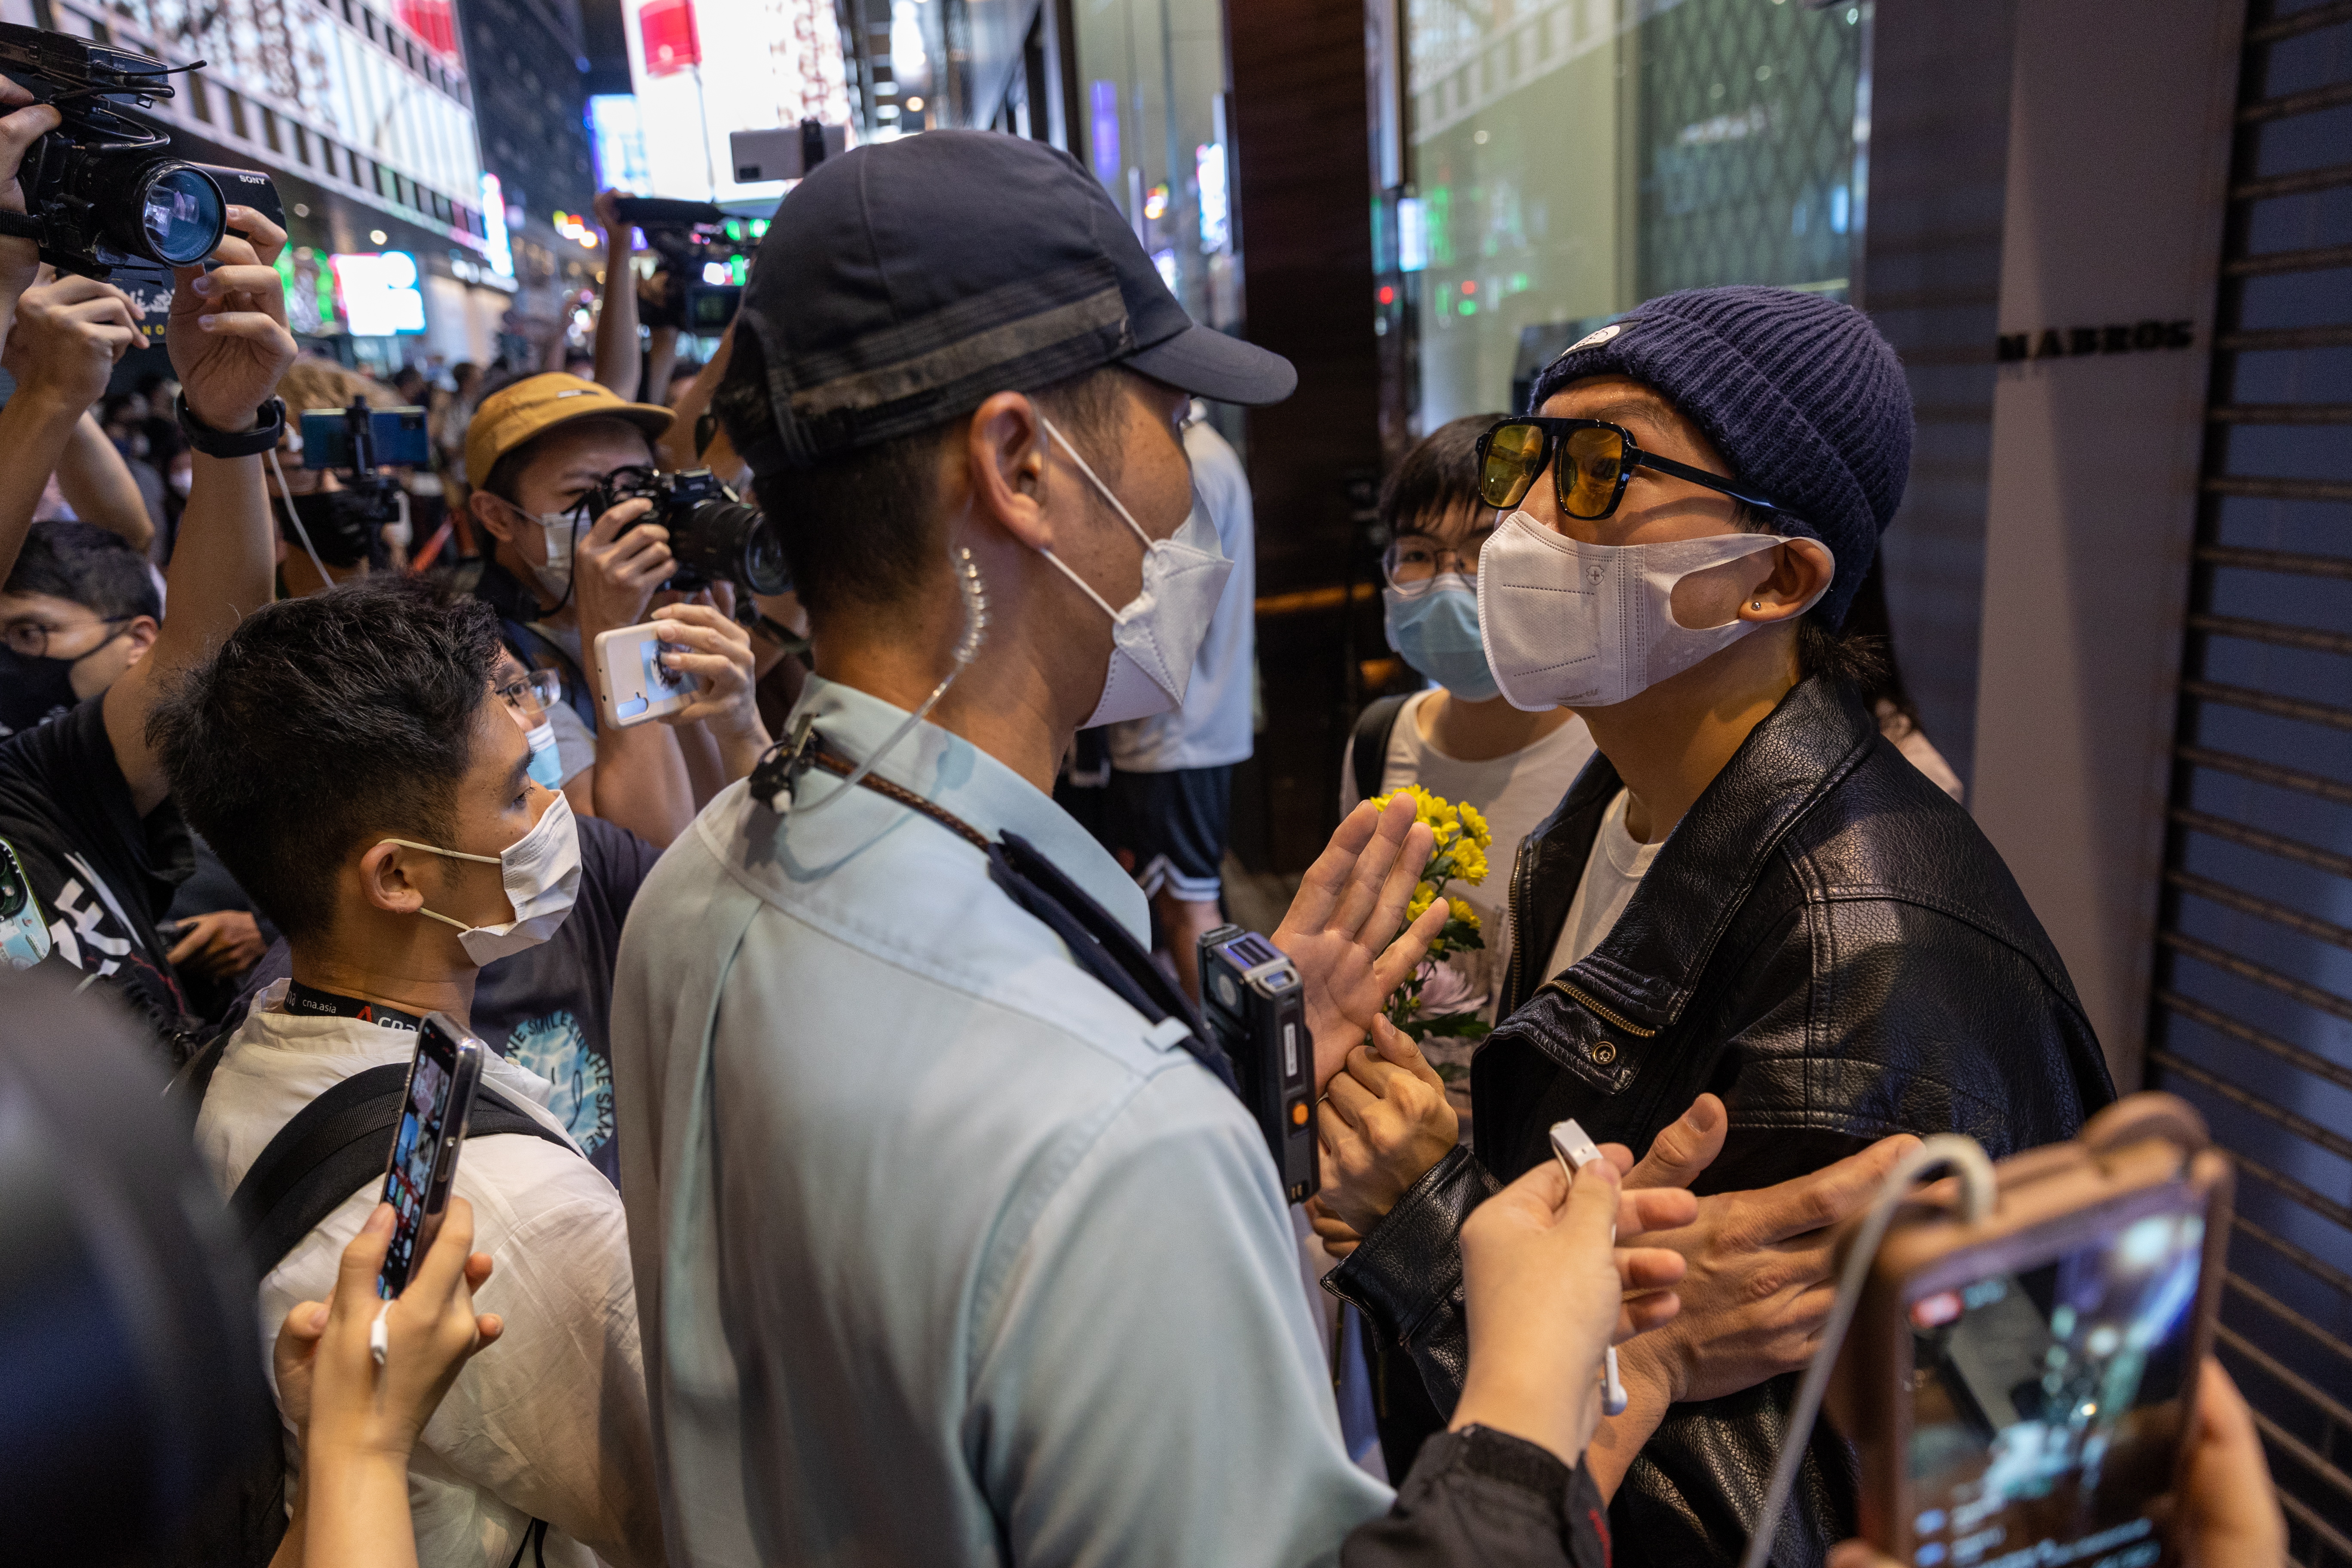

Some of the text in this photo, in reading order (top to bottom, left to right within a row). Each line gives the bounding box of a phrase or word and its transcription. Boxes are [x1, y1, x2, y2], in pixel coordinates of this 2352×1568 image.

[239, 175, 265, 185] SONY
[303, 999, 337, 1014] cna.asia
[527, 1012, 579, 1035] SMILES
[587, 1093, 612, 1153] SAME
